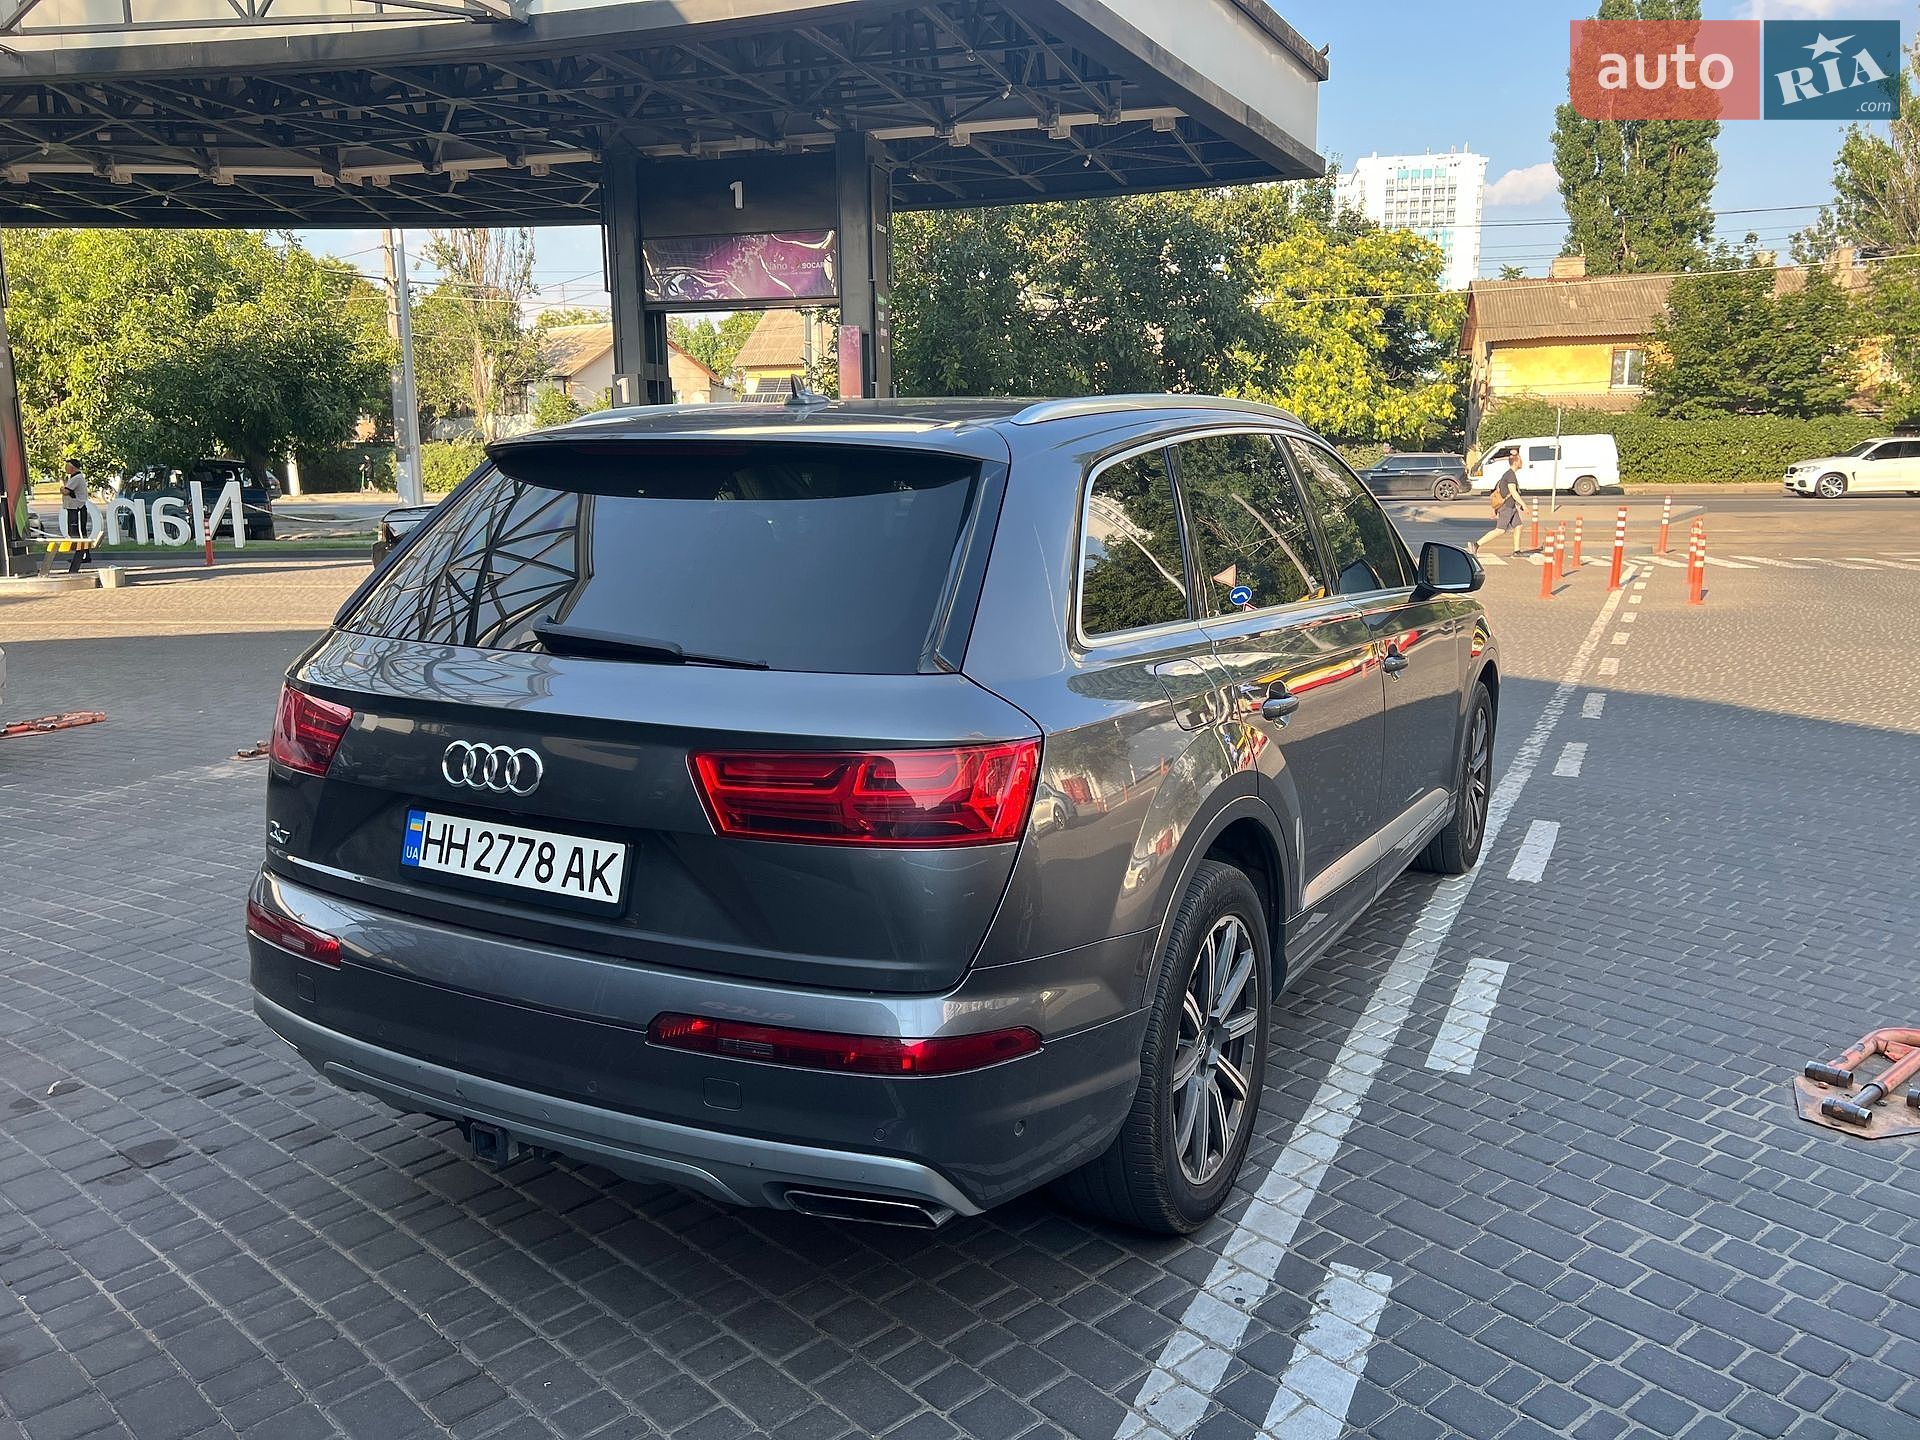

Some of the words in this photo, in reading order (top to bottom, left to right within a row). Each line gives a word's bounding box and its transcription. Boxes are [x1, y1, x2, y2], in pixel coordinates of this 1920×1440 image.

[730, 181, 744, 209] 1
[616, 377, 631, 404] 1
[406, 845, 419, 861] UA
[472, 831, 556, 884] 2778
[560, 846, 619, 897] AK
